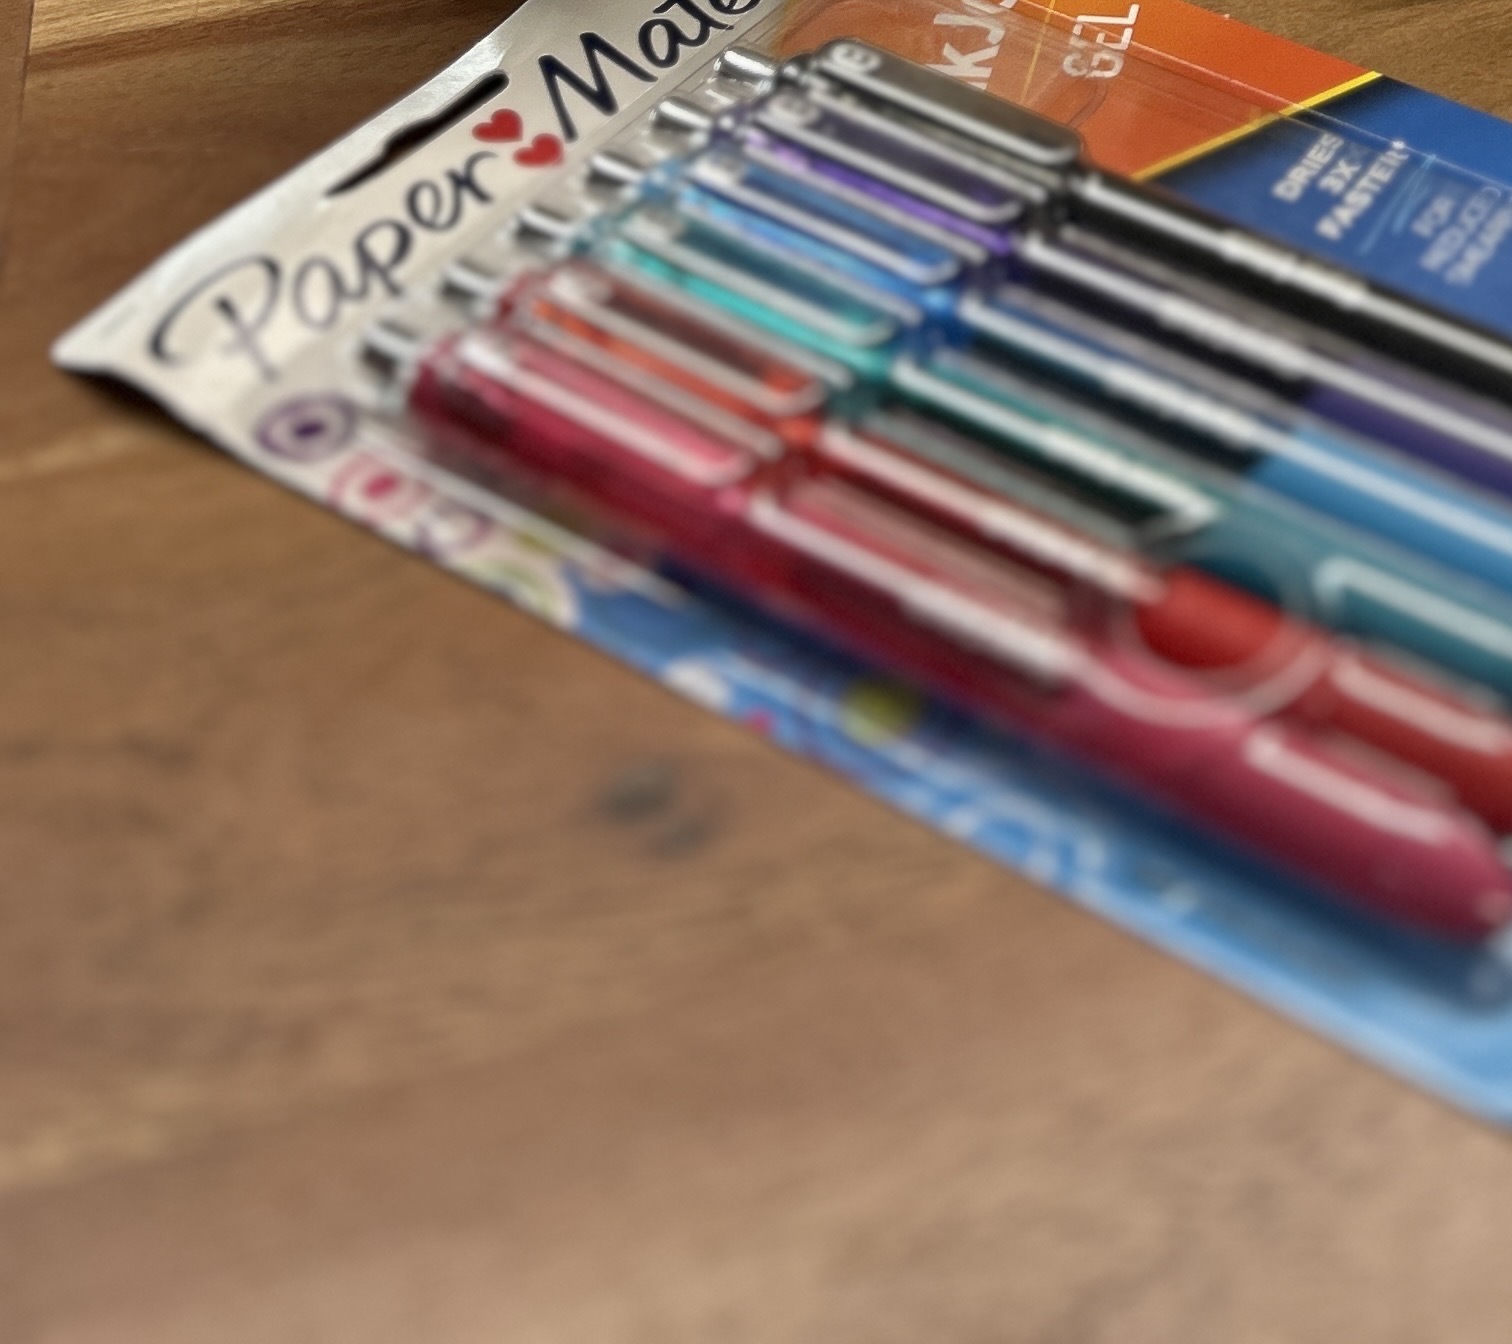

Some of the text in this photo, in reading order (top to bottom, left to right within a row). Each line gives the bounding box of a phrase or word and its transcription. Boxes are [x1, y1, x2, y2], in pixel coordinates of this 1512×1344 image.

[1063, 3, 1141, 79] GEL
[1271, 132, 1345, 204] DRIES
[1316, 159, 1362, 196] 3X
[147, 150, 498, 382] Paper
